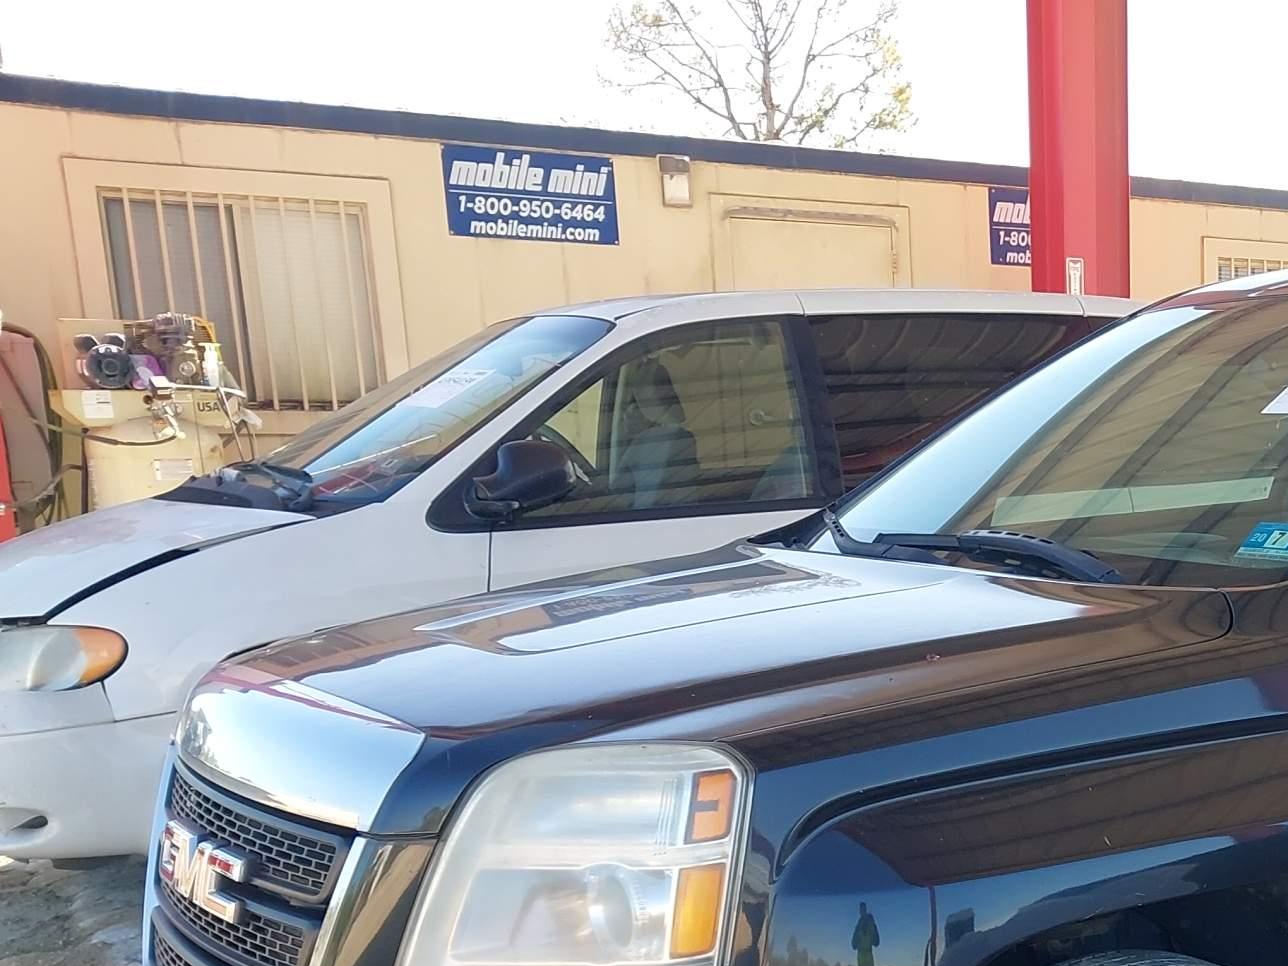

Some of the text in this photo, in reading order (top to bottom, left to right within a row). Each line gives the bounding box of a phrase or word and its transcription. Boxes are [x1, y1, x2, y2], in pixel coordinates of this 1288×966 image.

[449, 152, 610, 196] mobile mini
[458, 195, 606, 221] 1-800-950-6464
[470, 219, 600, 241] mobilemini.com
[999, 231, 1031, 247] 1-80
[197, 401, 220, 412] USA
[1249, 533, 1268, 543] 20
[1272, 532, 1288, 546] 7
